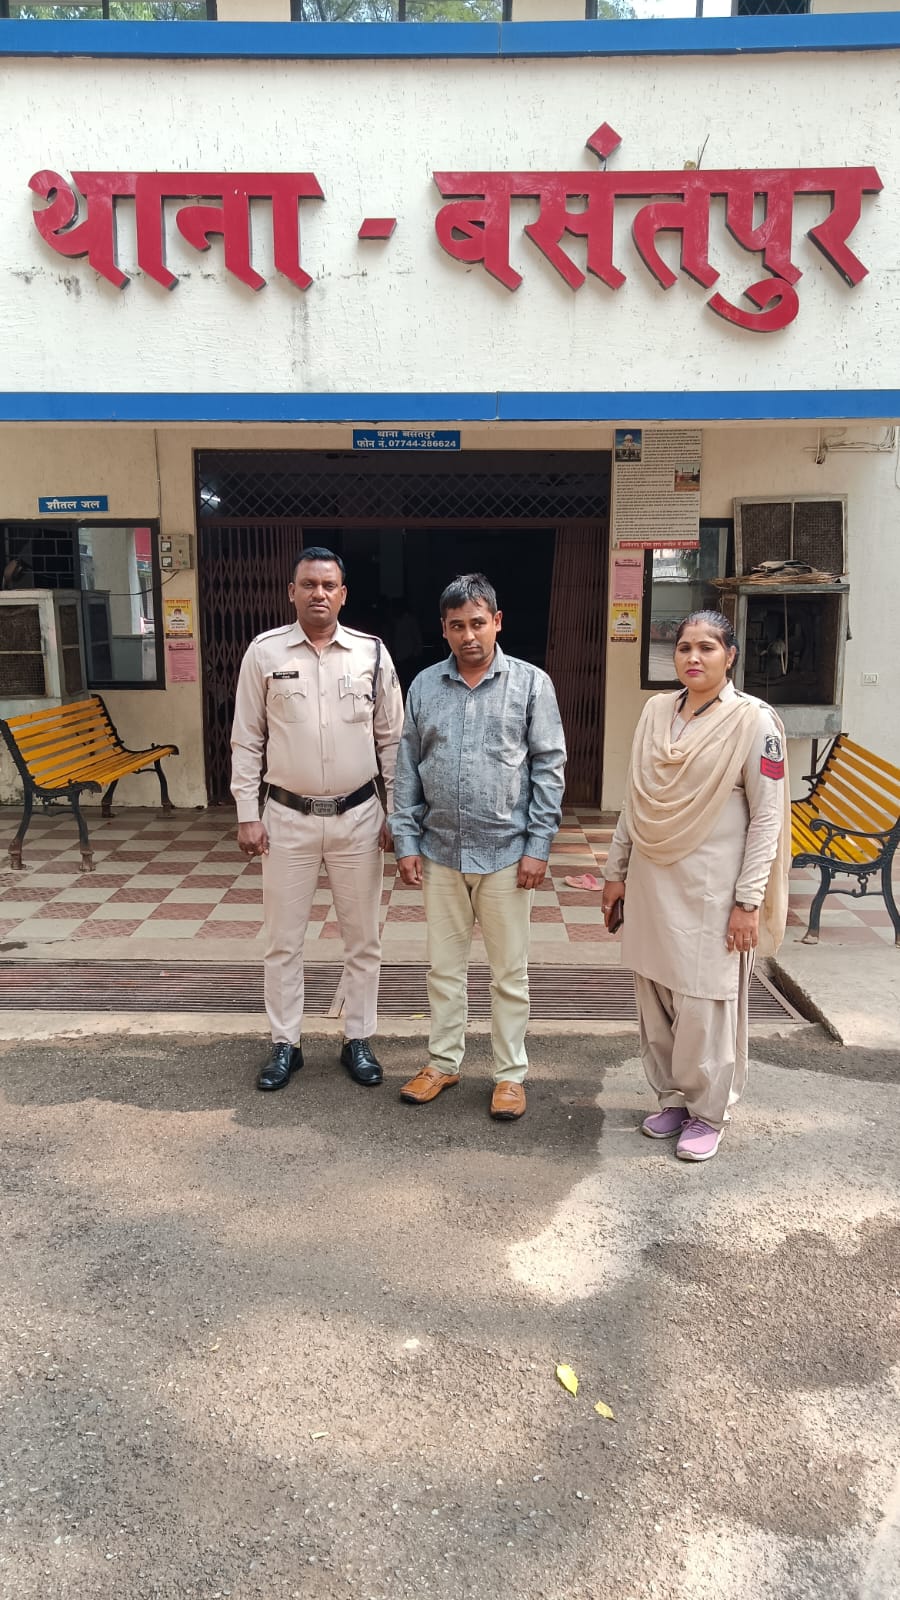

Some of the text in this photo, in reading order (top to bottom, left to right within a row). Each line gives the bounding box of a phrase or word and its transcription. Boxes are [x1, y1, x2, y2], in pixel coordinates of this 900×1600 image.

[28, 169, 325, 292] थाना
[432, 121, 885, 332] बसंतपुर
[377, 430, 398, 438] थाना
[357, 438, 375, 448] फोन
[45, 498, 101, 510] शीतल जल
